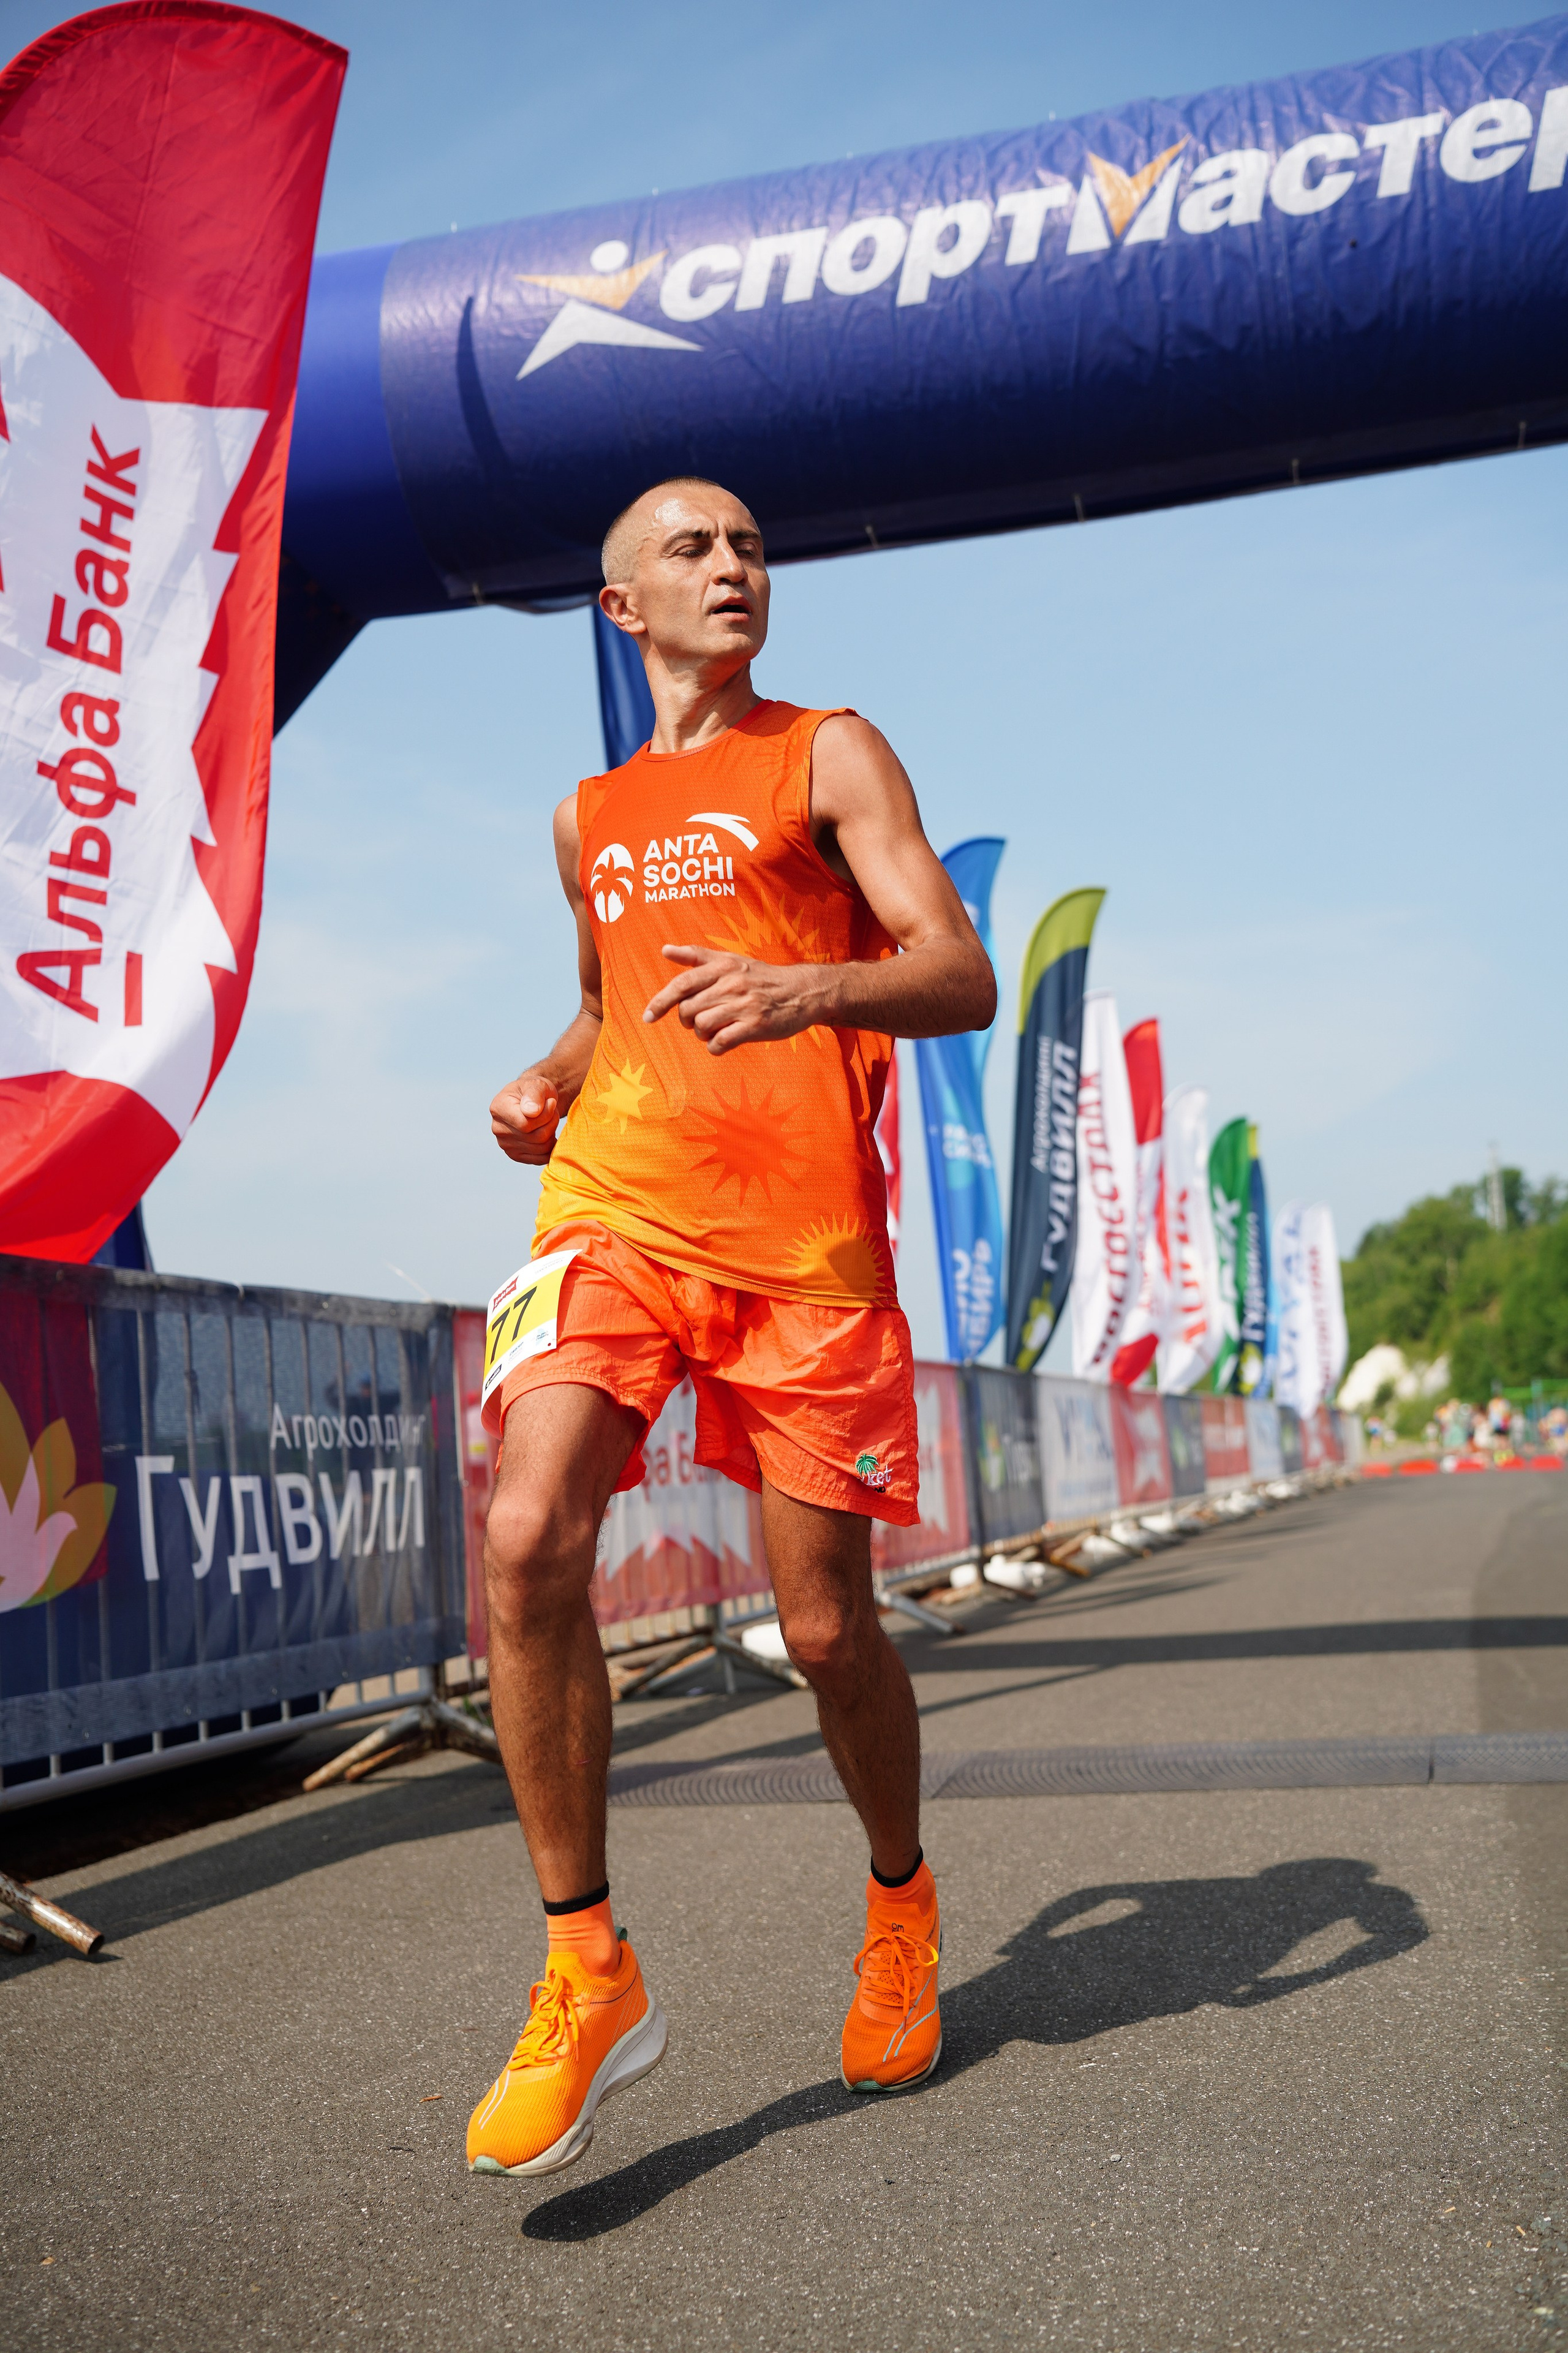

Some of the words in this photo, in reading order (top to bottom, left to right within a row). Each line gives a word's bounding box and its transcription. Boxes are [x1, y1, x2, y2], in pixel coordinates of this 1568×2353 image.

[46, 421, 140, 675] Банк
[16, 689, 137, 1023] Альфа
[643, 833, 719, 863] ANTA
[643, 856, 734, 888] SOCHI
[645, 883, 735, 904] MARATHON
[490, 1285, 538, 1365] 77
[270, 1403, 426, 1460] Агрохолдинг
